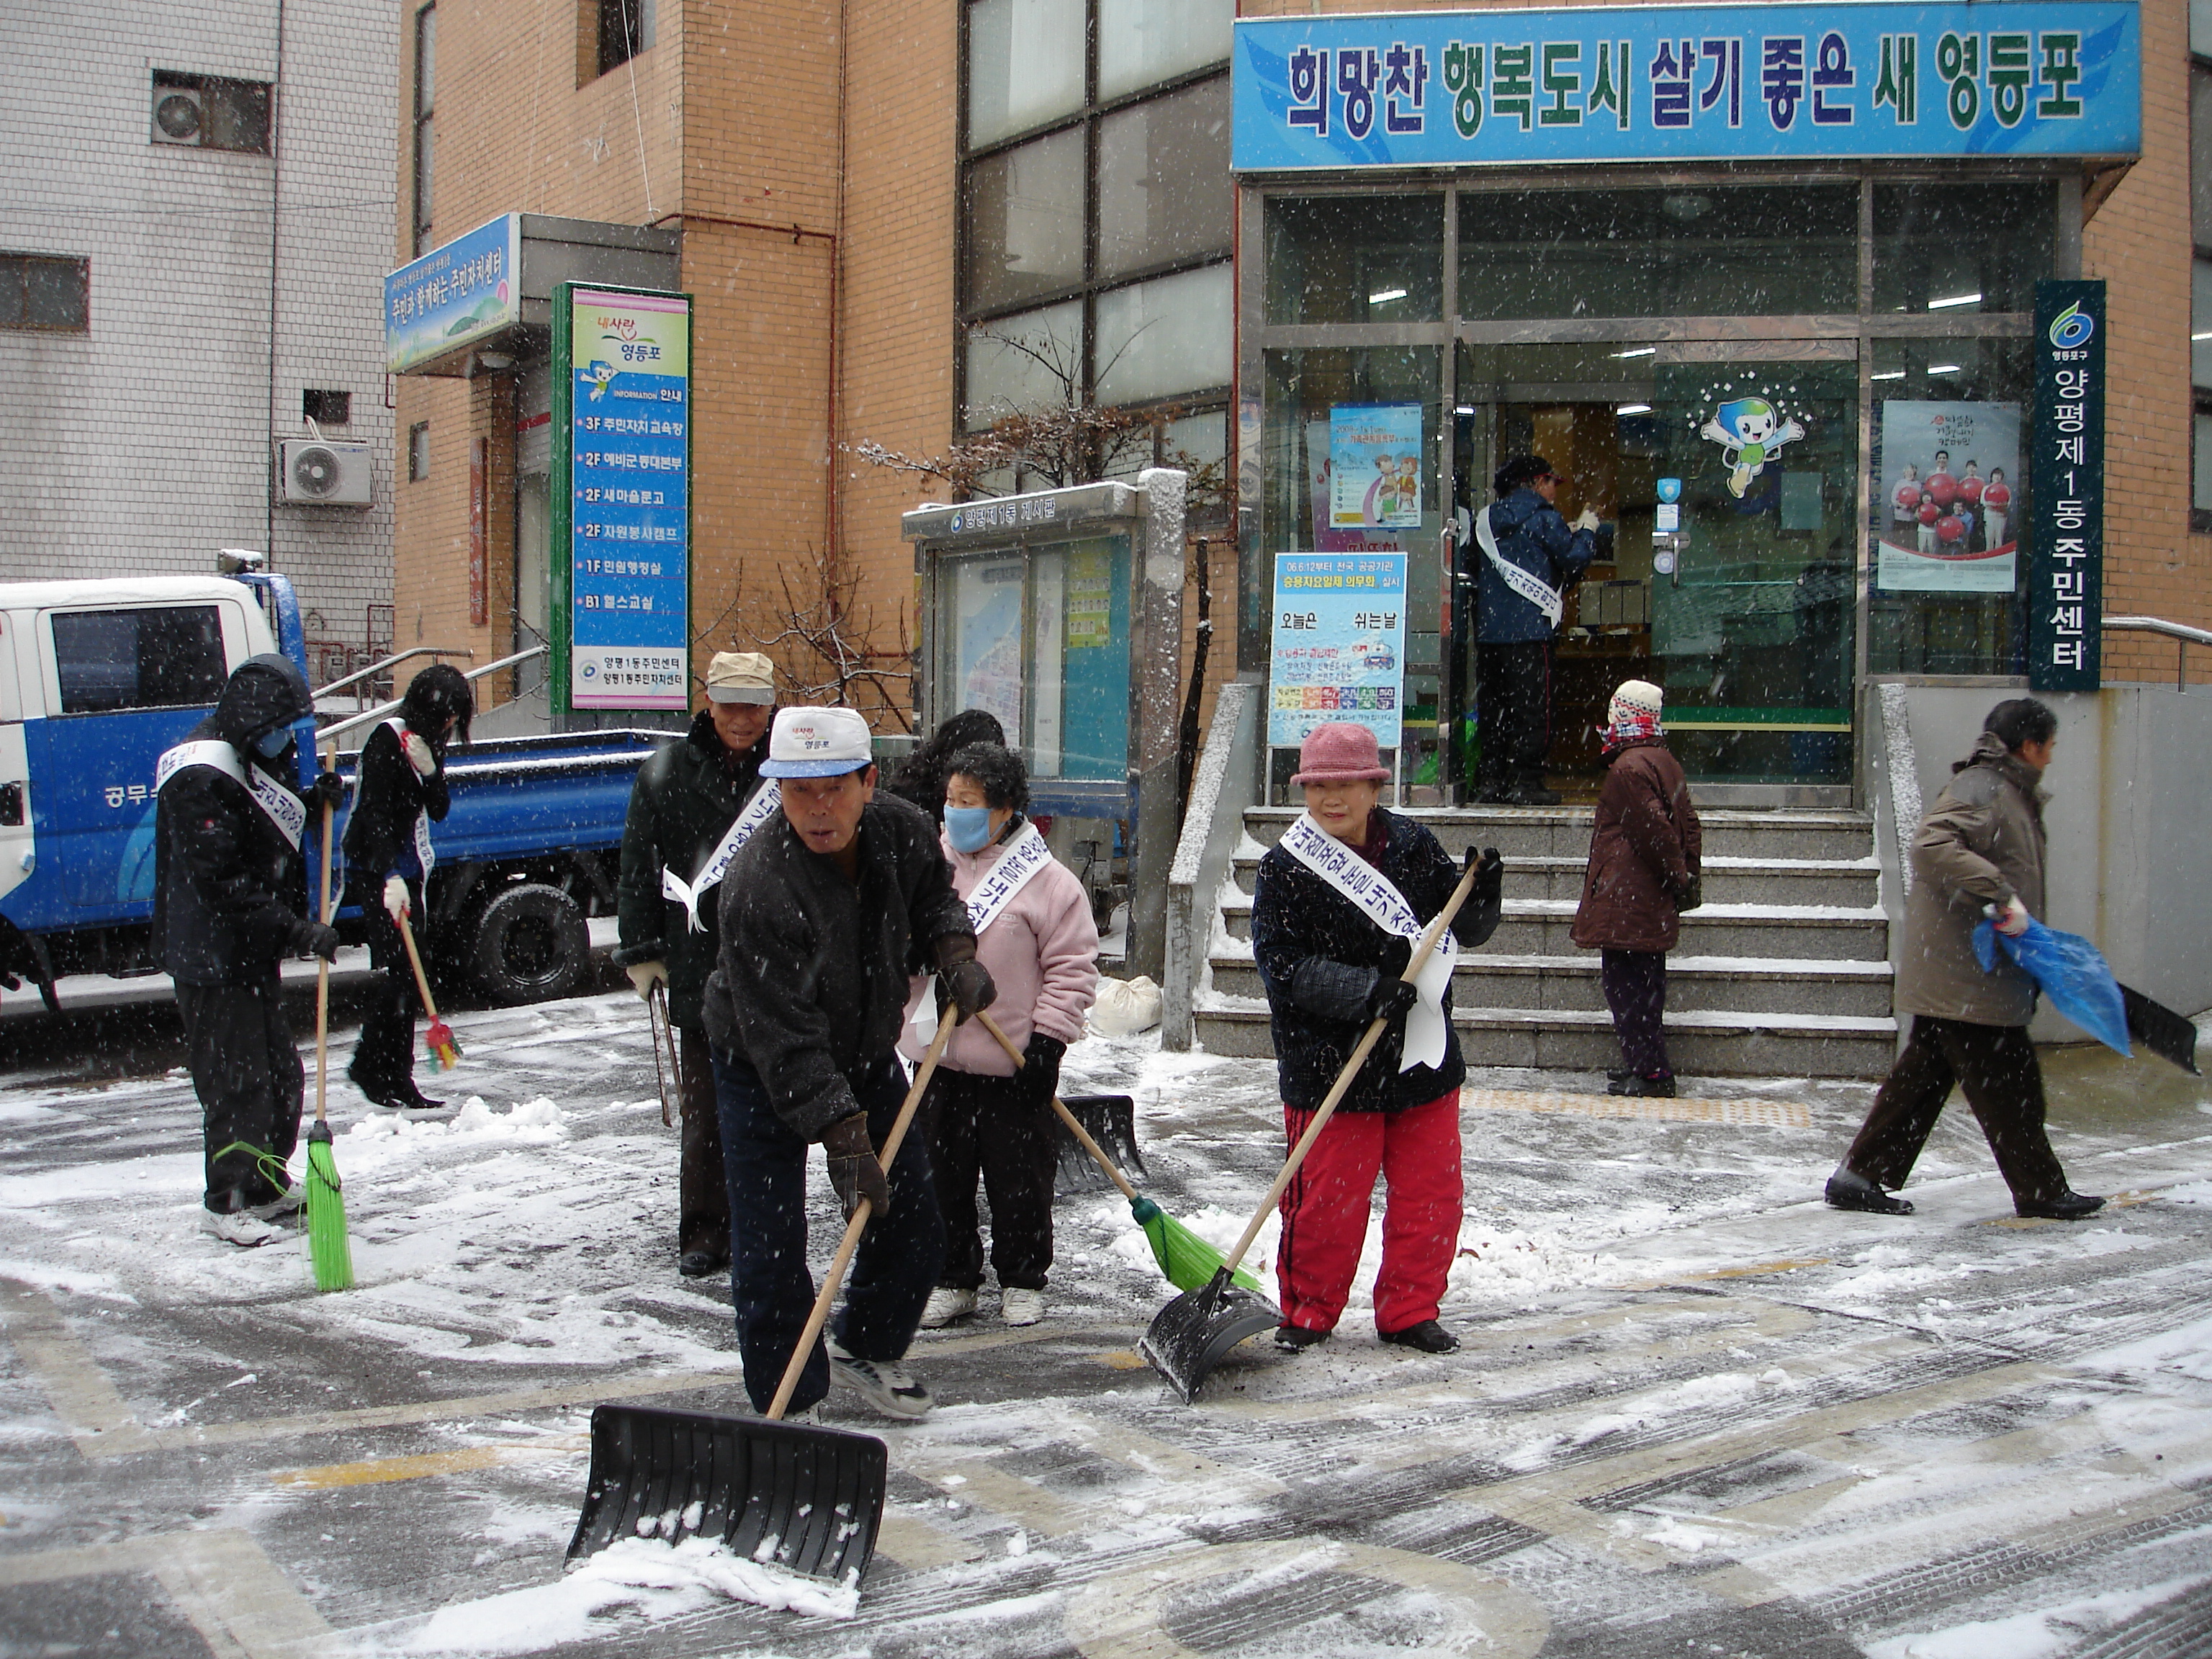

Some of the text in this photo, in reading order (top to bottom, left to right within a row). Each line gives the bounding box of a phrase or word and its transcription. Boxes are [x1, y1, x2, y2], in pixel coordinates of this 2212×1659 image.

[1288, 32, 2083, 140] 희망찬 행복도시 살기 좋은 새 영등포
[392, 246, 502, 325] 주민과 함께하는 주민자치센터
[597, 317, 636, 330] 내사랑
[621, 344, 661, 361] 영등포
[2052, 350, 2088, 361] 영등포구
[613, 389, 683, 403] INFORMATION 안내
[585, 416, 683, 436] 3F 주민자치 교육장
[585, 452, 682, 470] 2F 예비군 동대본부
[585, 488, 664, 505] 2F 새마을문고
[966, 498, 1056, 529] 양평제1동 게시판
[2050, 369, 2089, 670] 양평제1동주민센터
[585, 523, 678, 541] 2F 자원봉사캠프
[586, 559, 661, 576] 1F 민원행정실
[1336, 562, 1354, 572] 전국
[1358, 561, 1394, 572] 공공기관
[1382, 576, 1401, 588] 실시
[585, 595, 652, 611] B1 헬스교실
[1280, 612, 1318, 629] 오늘은
[604, 657, 680, 670] 양평1동주민센터
[603, 673, 682, 685] 양평1동주민자치센터
[805, 740, 830, 750] 영등포
[999, 855, 1028, 884] 눈은
[979, 877, 1010, 906] 내가
[1341, 865, 1372, 895] 눈은
[1366, 884, 1398, 916] 내가
